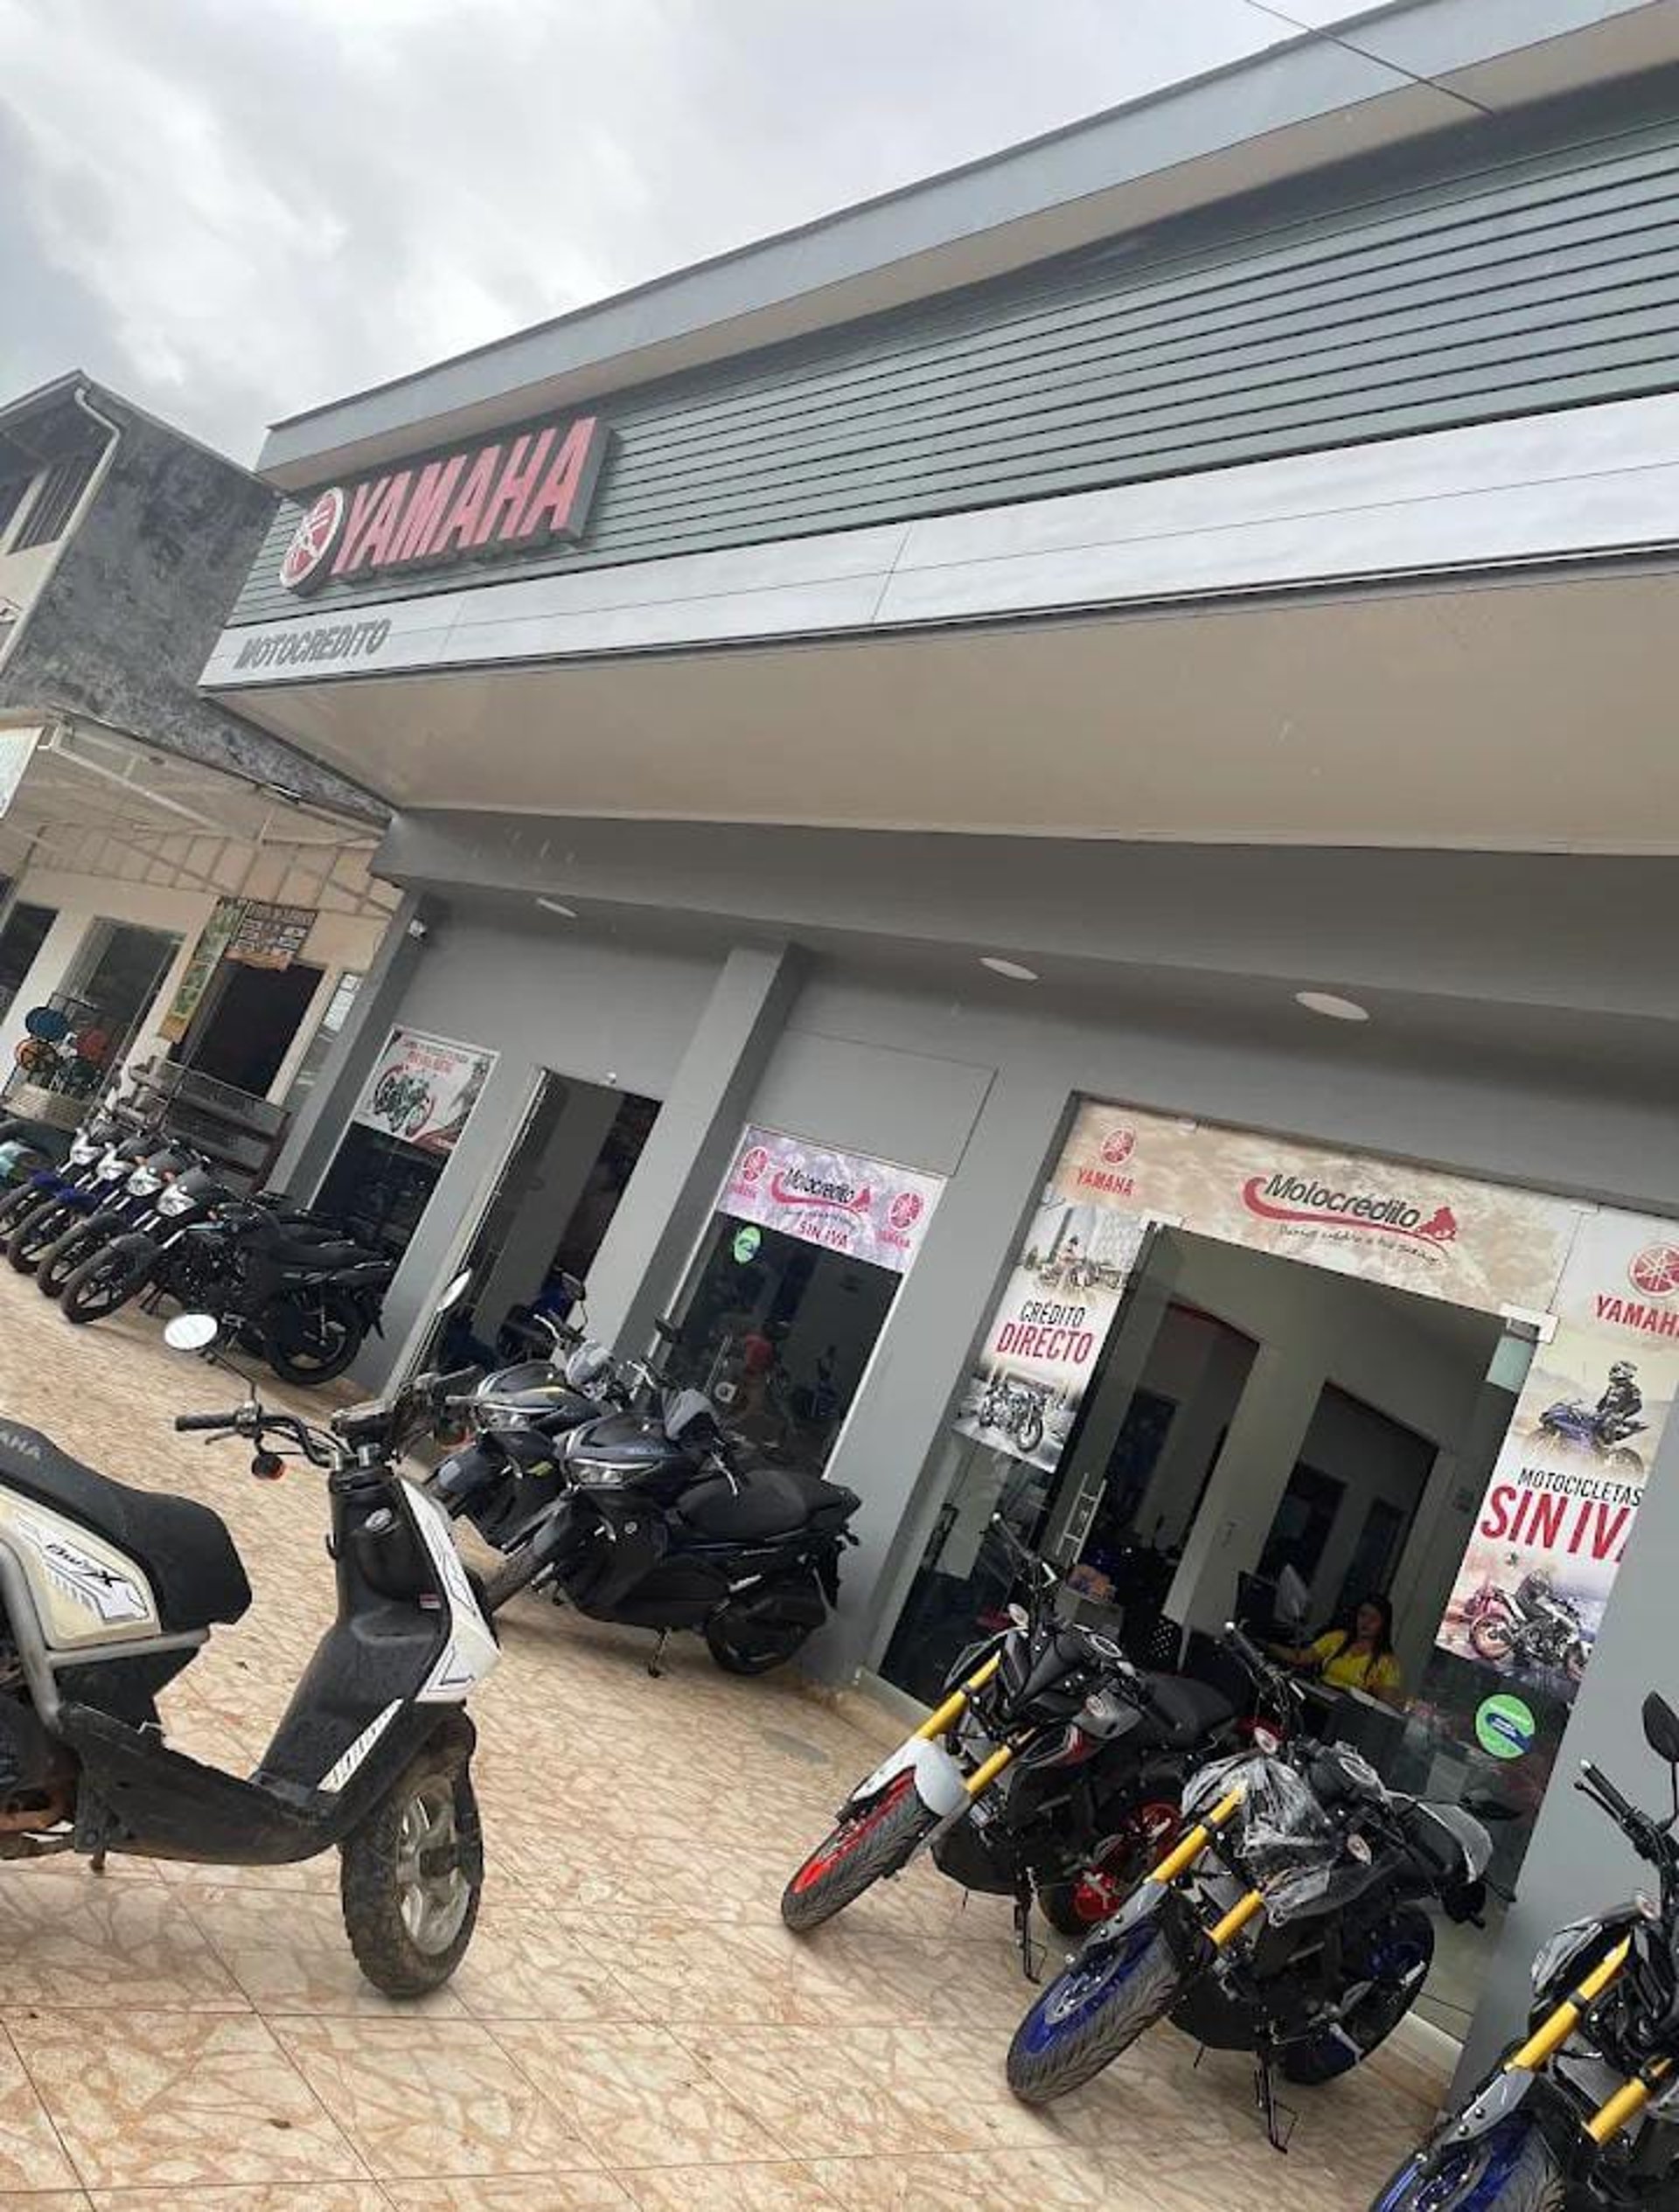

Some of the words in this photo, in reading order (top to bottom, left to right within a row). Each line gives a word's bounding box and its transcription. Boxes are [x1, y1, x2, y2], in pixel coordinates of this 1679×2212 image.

[331, 417, 596, 576] YAMAHA
[233, 617, 392, 670] MOTOCREDITO
[1076, 1166, 1137, 1197] YAMAHA
[1597, 1294, 1679, 1339] YAMAH
[995, 1323, 1094, 1364] DIRECTO
[1518, 1468, 1645, 1506] MOTOCICLETAS
[1480, 1484, 1569, 1549] SIN
[1567, 1499, 1632, 1562] IV
